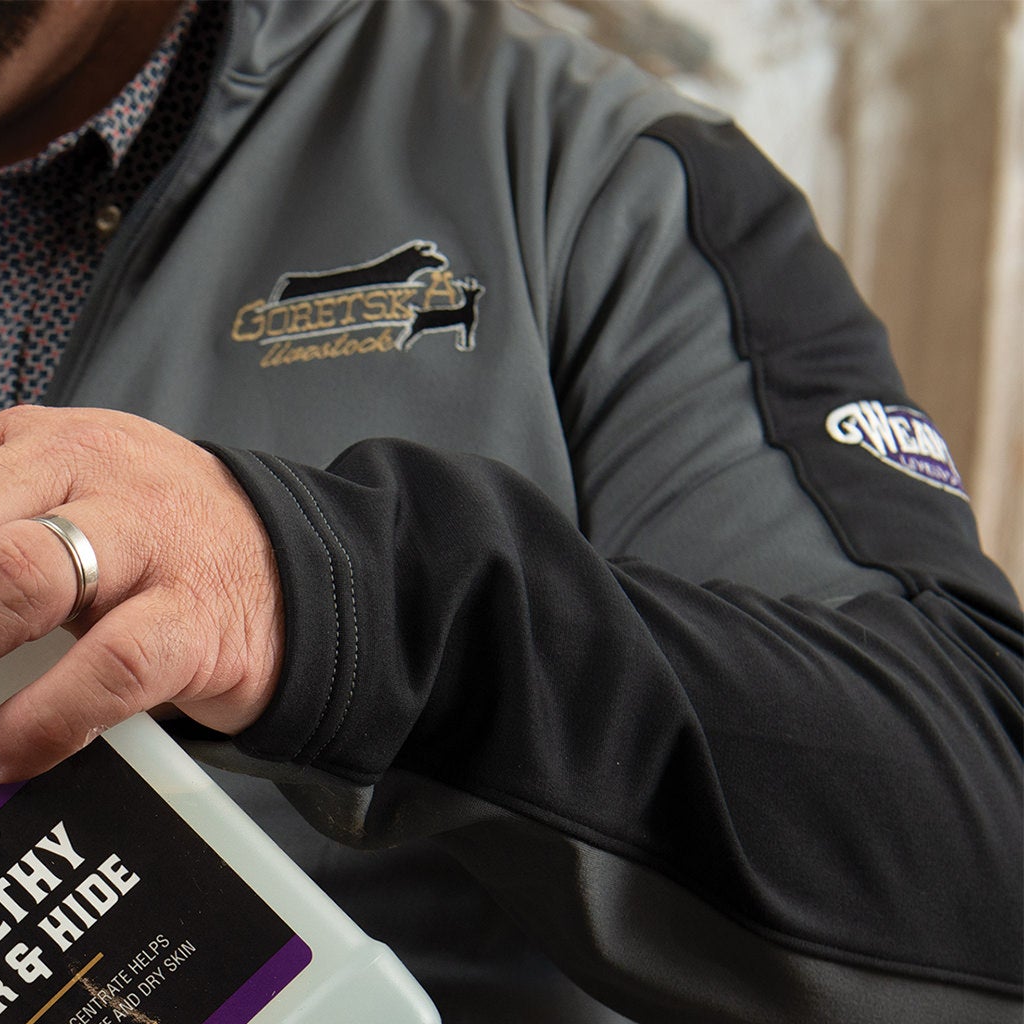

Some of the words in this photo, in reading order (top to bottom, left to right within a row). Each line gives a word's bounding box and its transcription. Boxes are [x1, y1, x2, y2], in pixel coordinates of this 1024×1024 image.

[231, 271, 456, 342] GORETSKA
[4, 942, 53, 984] &
[37, 853, 141, 952] HIDE
[127, 934, 171, 975] HELPS
[114, 992, 141, 1023] AND
[137, 967, 166, 997] DRY
[164, 940, 196, 972] SKIN
